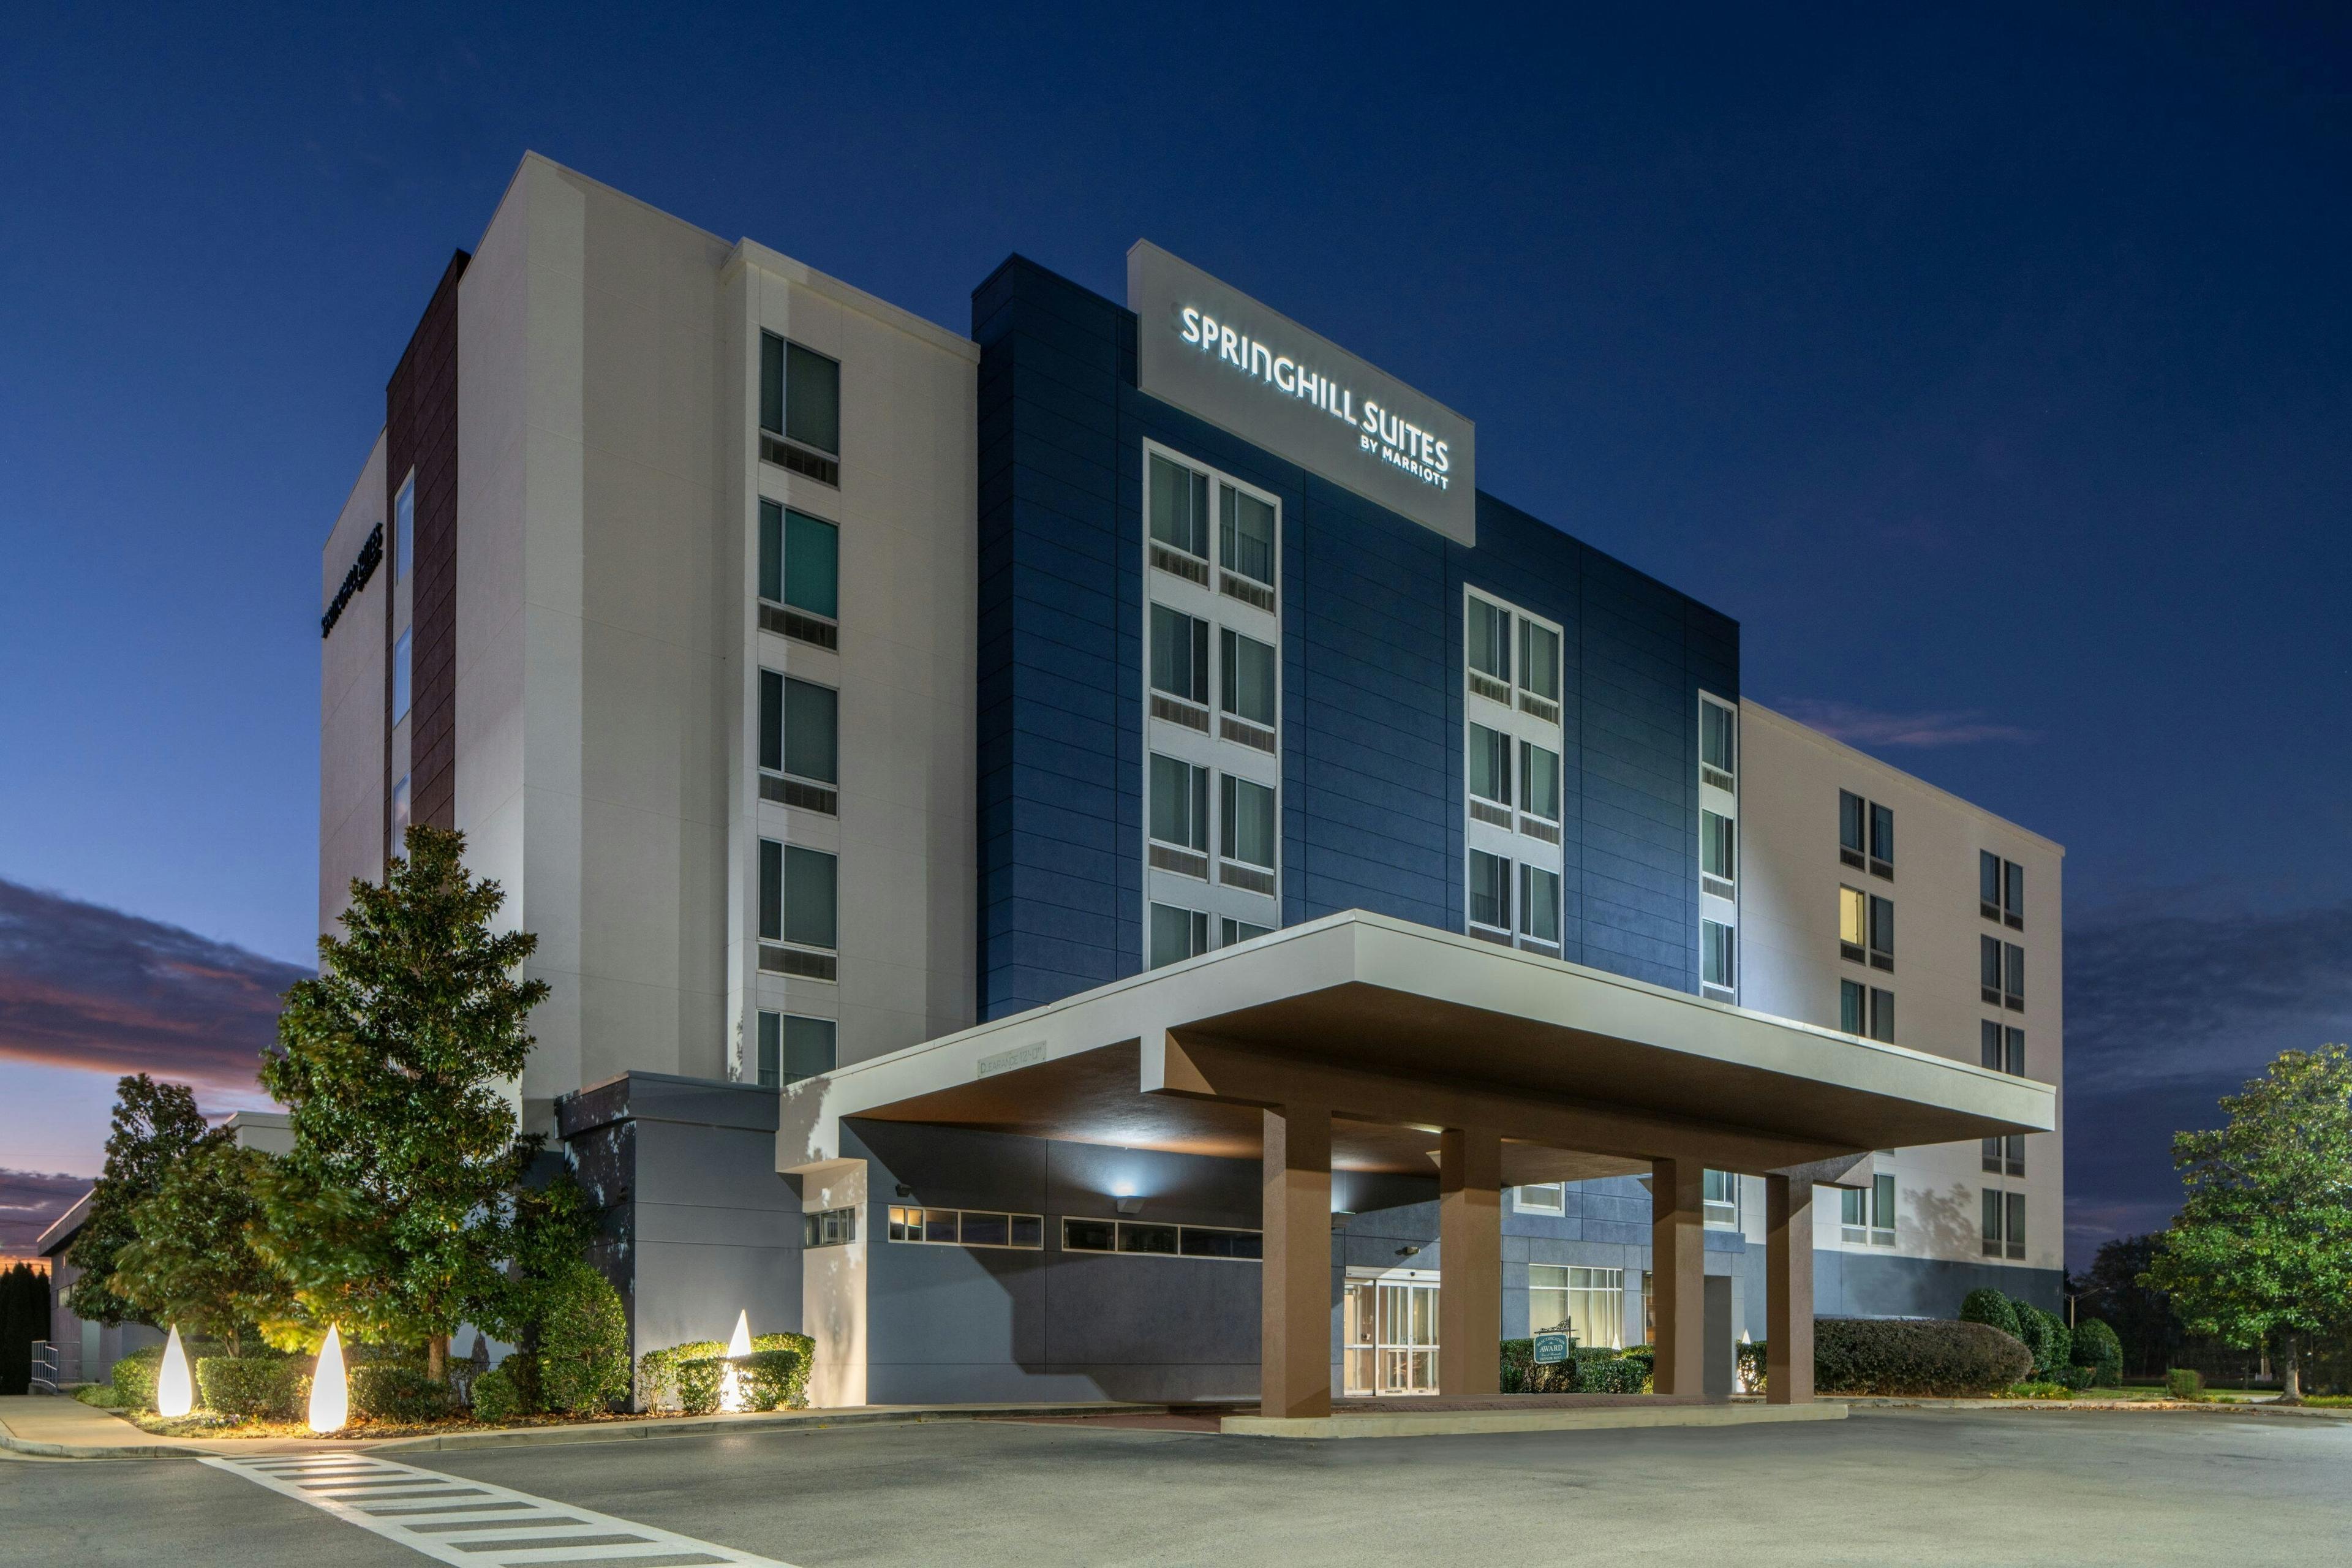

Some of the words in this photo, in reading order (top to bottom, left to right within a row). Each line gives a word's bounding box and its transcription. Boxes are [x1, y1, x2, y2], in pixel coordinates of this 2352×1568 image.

[1182, 307, 1357, 425] SPRINGHILL
[1362, 401, 1449, 472] SUITES
[1360, 434, 1378, 454] BY
[1382, 445, 1449, 489] MARRIOTT
[981, 1055, 1019, 1074] CLEARANCE
